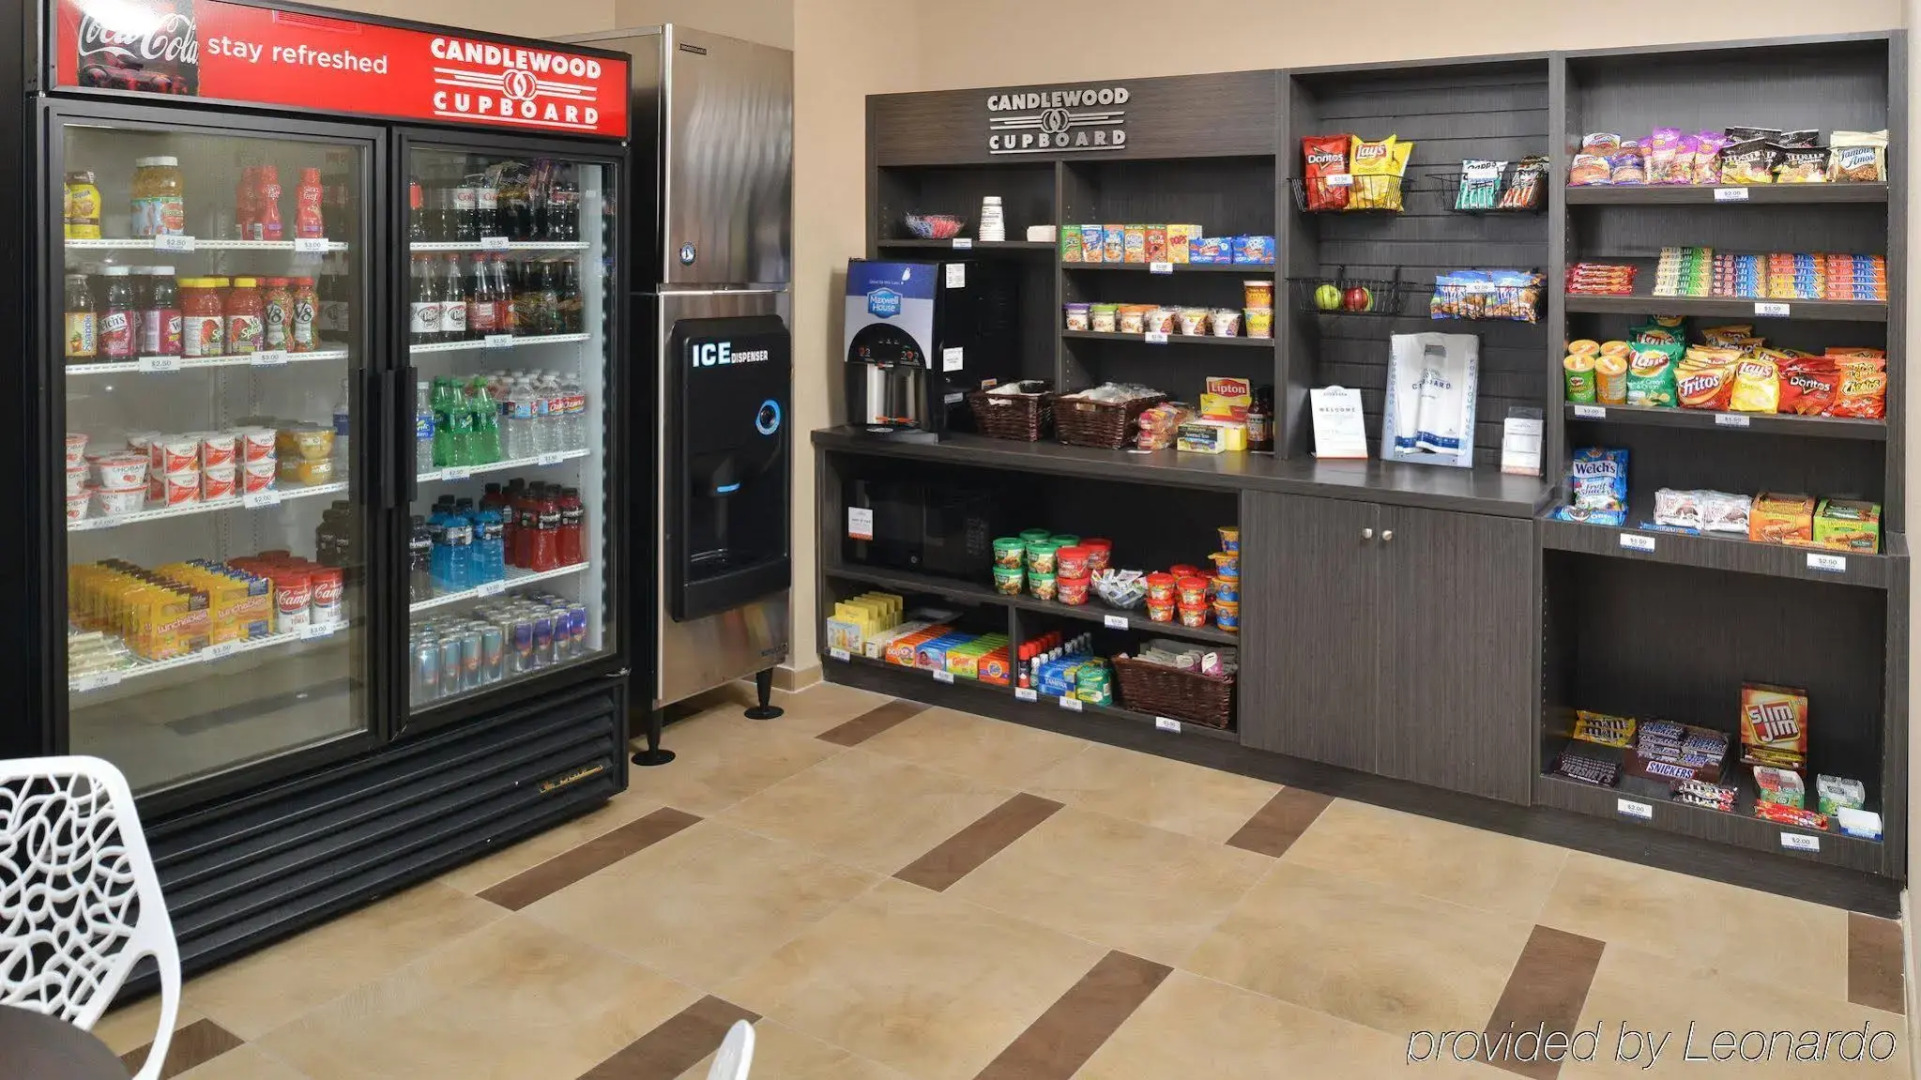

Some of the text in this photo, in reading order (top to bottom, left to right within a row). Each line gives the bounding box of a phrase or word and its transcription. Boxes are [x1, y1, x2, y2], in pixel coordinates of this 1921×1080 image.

[208, 36, 388, 74] stay refreshed
[431, 38, 602, 79] CANDLEWOOD
[433, 91, 599, 125] CUPBOARD
[987, 88, 1129, 111] CANDLEWOOD
[989, 130, 1126, 149] CUPBOARD
[1308, 154, 1344, 164] Doritos
[870, 295, 899, 305] Maxwell
[872, 303, 896, 311] House
[294, 303, 313, 321] V8
[693, 342, 769, 367] ICE DISPENSER
[1211, 381, 1246, 395] Lipton
[1683, 375, 1719, 397] Fritos
[1790, 376, 1831, 392] Doritos
[1574, 461, 1616, 475] Welch's
[1648, 762, 1693, 779] SNICKERS
[1627, 804, 1645, 812] $2.00
[1792, 837, 1811, 845] $2.00
